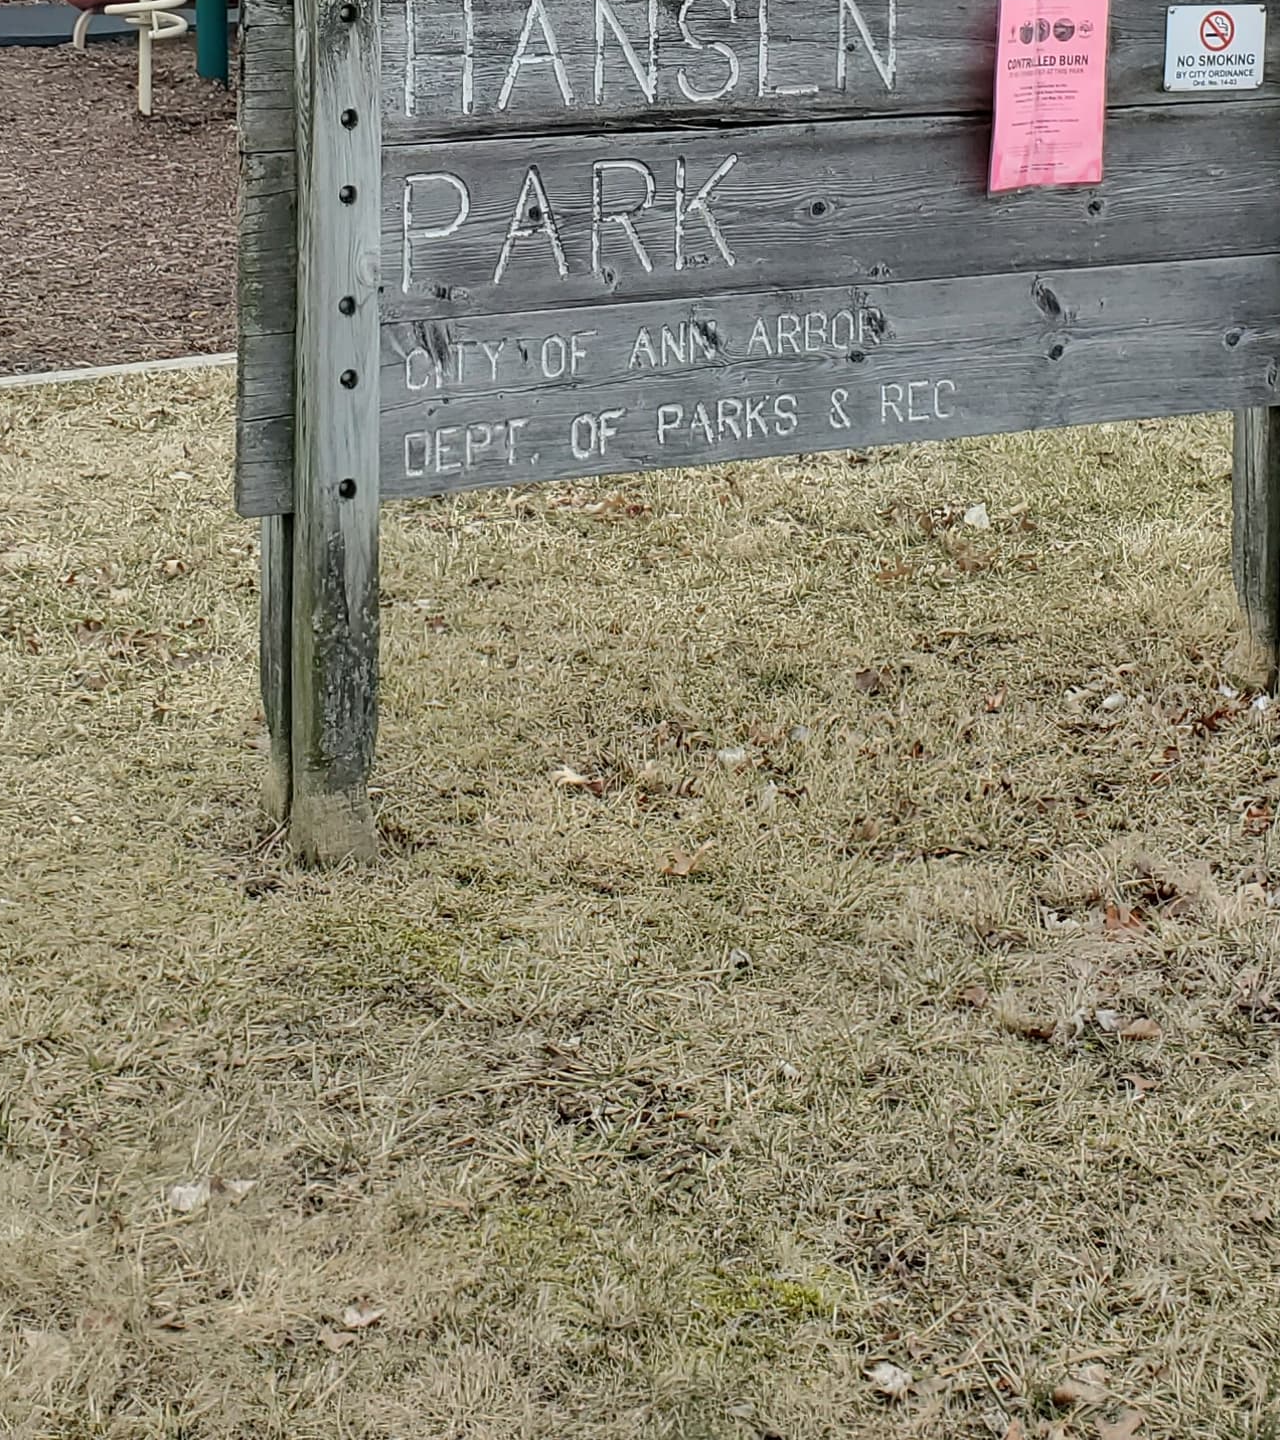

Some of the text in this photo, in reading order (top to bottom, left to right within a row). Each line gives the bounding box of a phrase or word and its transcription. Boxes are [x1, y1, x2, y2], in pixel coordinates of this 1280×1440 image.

[1007, 54, 1089, 70] CONTRLED BURN
[1176, 68, 1255, 79] BY CITY ORDINANCE
[1177, 53, 1256, 67] NO SMOKING
[402, 152, 740, 295] PARK
[404, 307, 887, 391] CITY OF ANN ARBOR
[403, 378, 957, 477] DEPT. OF PARKS & REC
